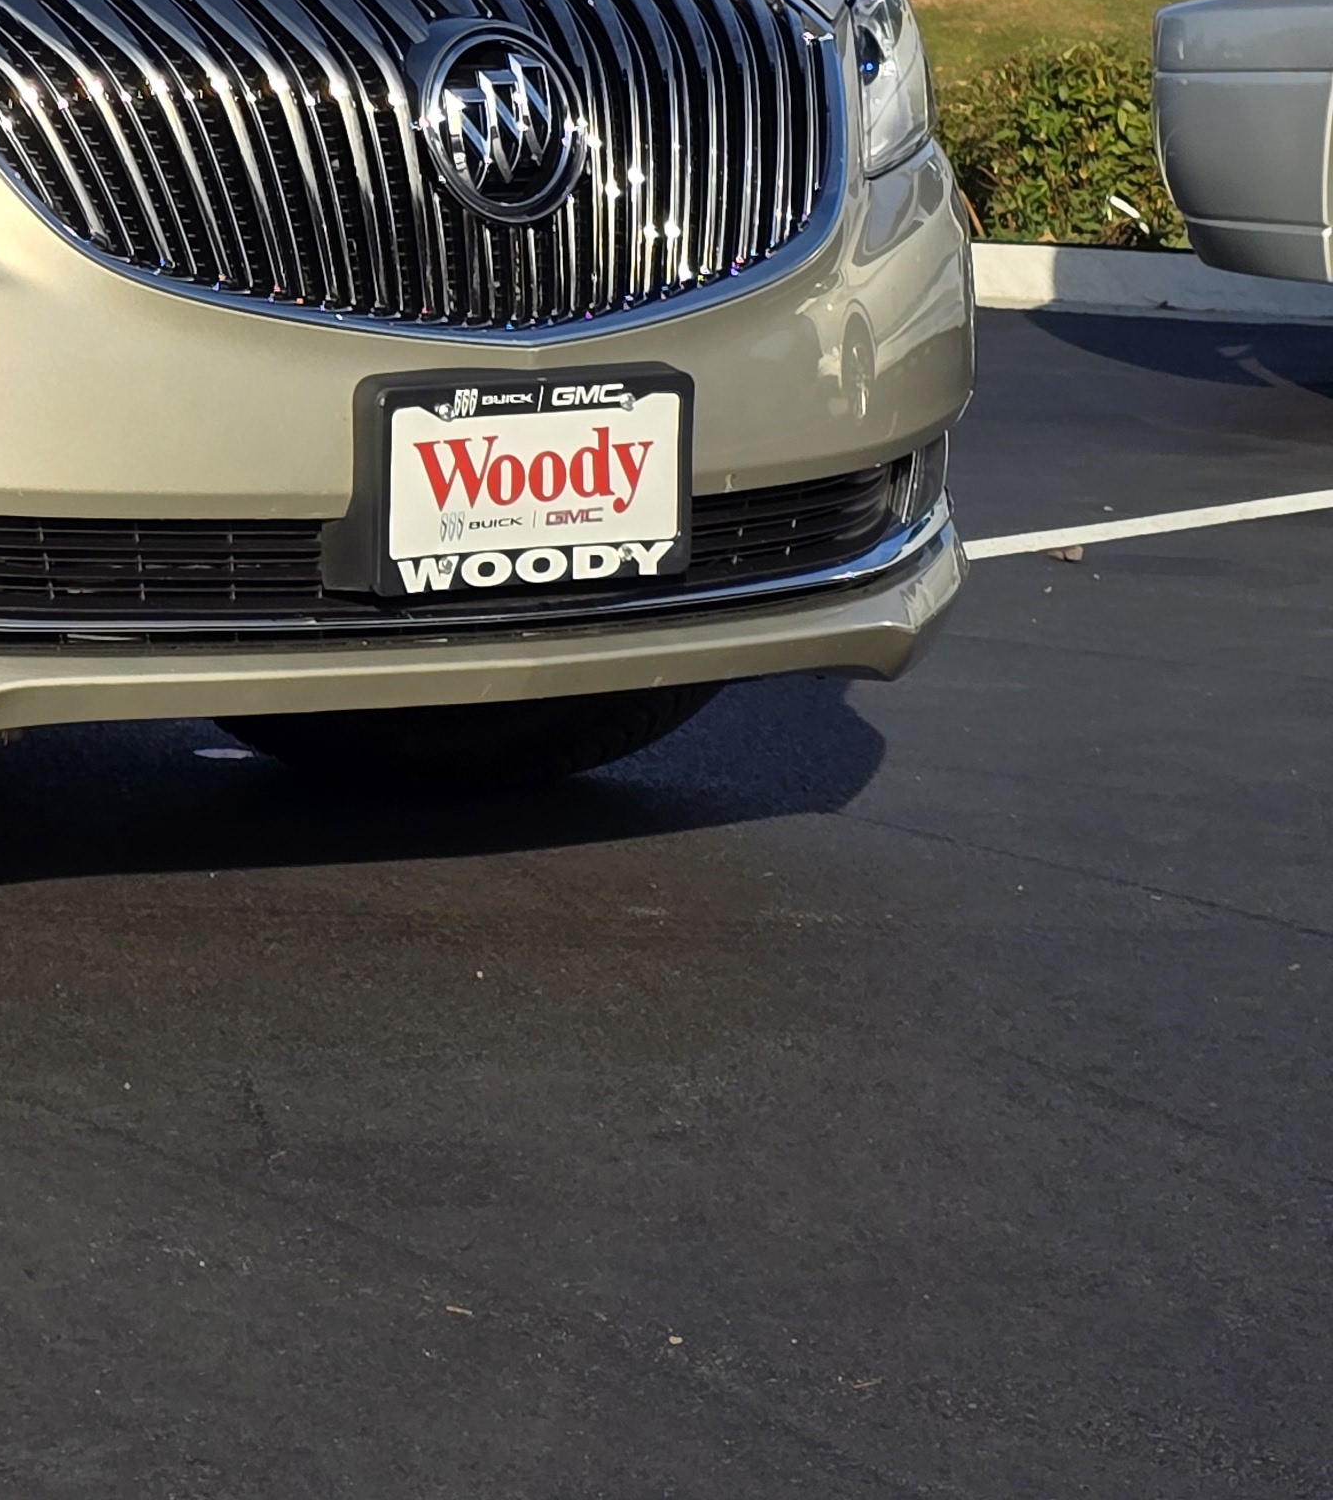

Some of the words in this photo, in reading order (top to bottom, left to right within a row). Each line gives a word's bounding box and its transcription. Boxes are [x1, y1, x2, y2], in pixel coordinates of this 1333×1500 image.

[482, 392, 533, 406] BUICK
[551, 383, 625, 407] GMC
[413, 426, 654, 514] Woody
[468, 516, 524, 530] BUICK
[545, 506, 604, 527] GMC
[396, 540, 675, 594] WOODY
